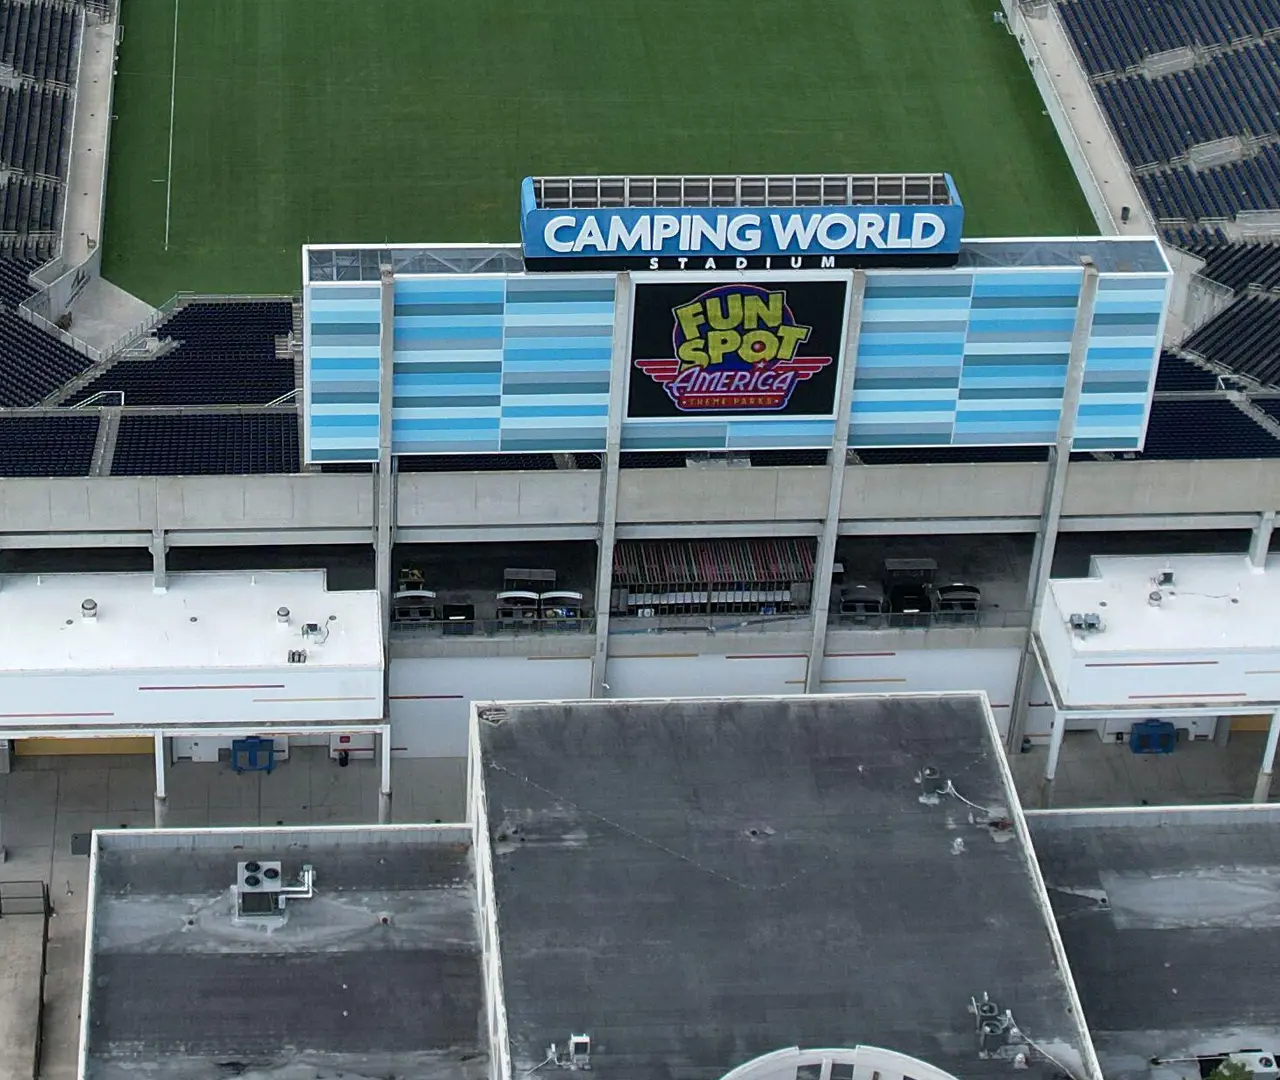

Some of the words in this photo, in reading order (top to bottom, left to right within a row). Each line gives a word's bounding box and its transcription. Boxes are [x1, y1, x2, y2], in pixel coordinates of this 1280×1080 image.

[544, 214, 761, 253] CAMPING
[769, 212, 946, 250] WORLD
[649, 256, 836, 269] STADIUM
[676, 293, 783, 339] FUN
[677, 325, 809, 370] SPOT
[670, 366, 793, 396] AMERICA
[689, 398, 727, 406] THEME
[733, 397, 772, 406] PARKS
